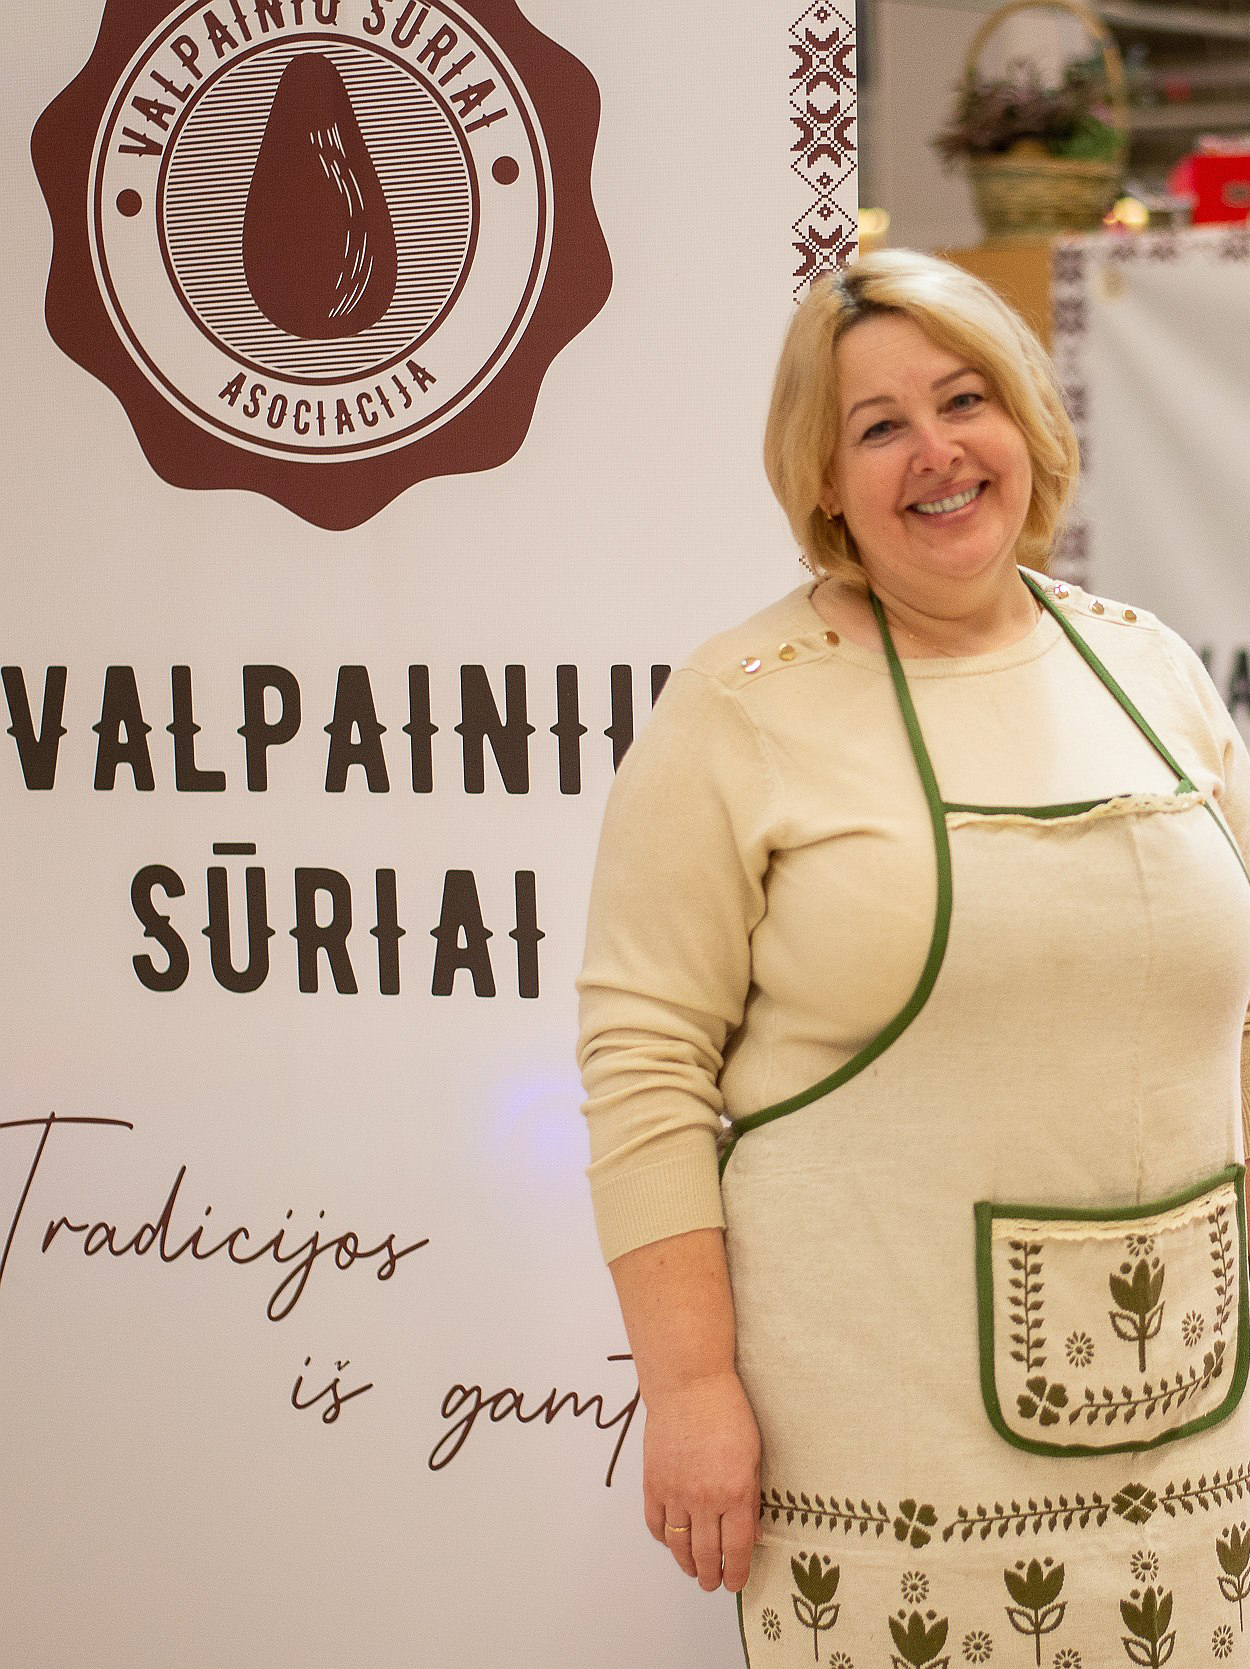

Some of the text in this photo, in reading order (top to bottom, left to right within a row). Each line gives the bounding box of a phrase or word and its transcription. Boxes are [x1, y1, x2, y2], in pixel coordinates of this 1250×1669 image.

[362, 0, 508, 134] SŪRIAI
[217, 359, 437, 436] ASOCIACIJA
[130, 842, 546, 999] SŪRIAI
[0, 1111, 429, 1321] Tradicijos
[290, 1355, 373, 1425] iš
